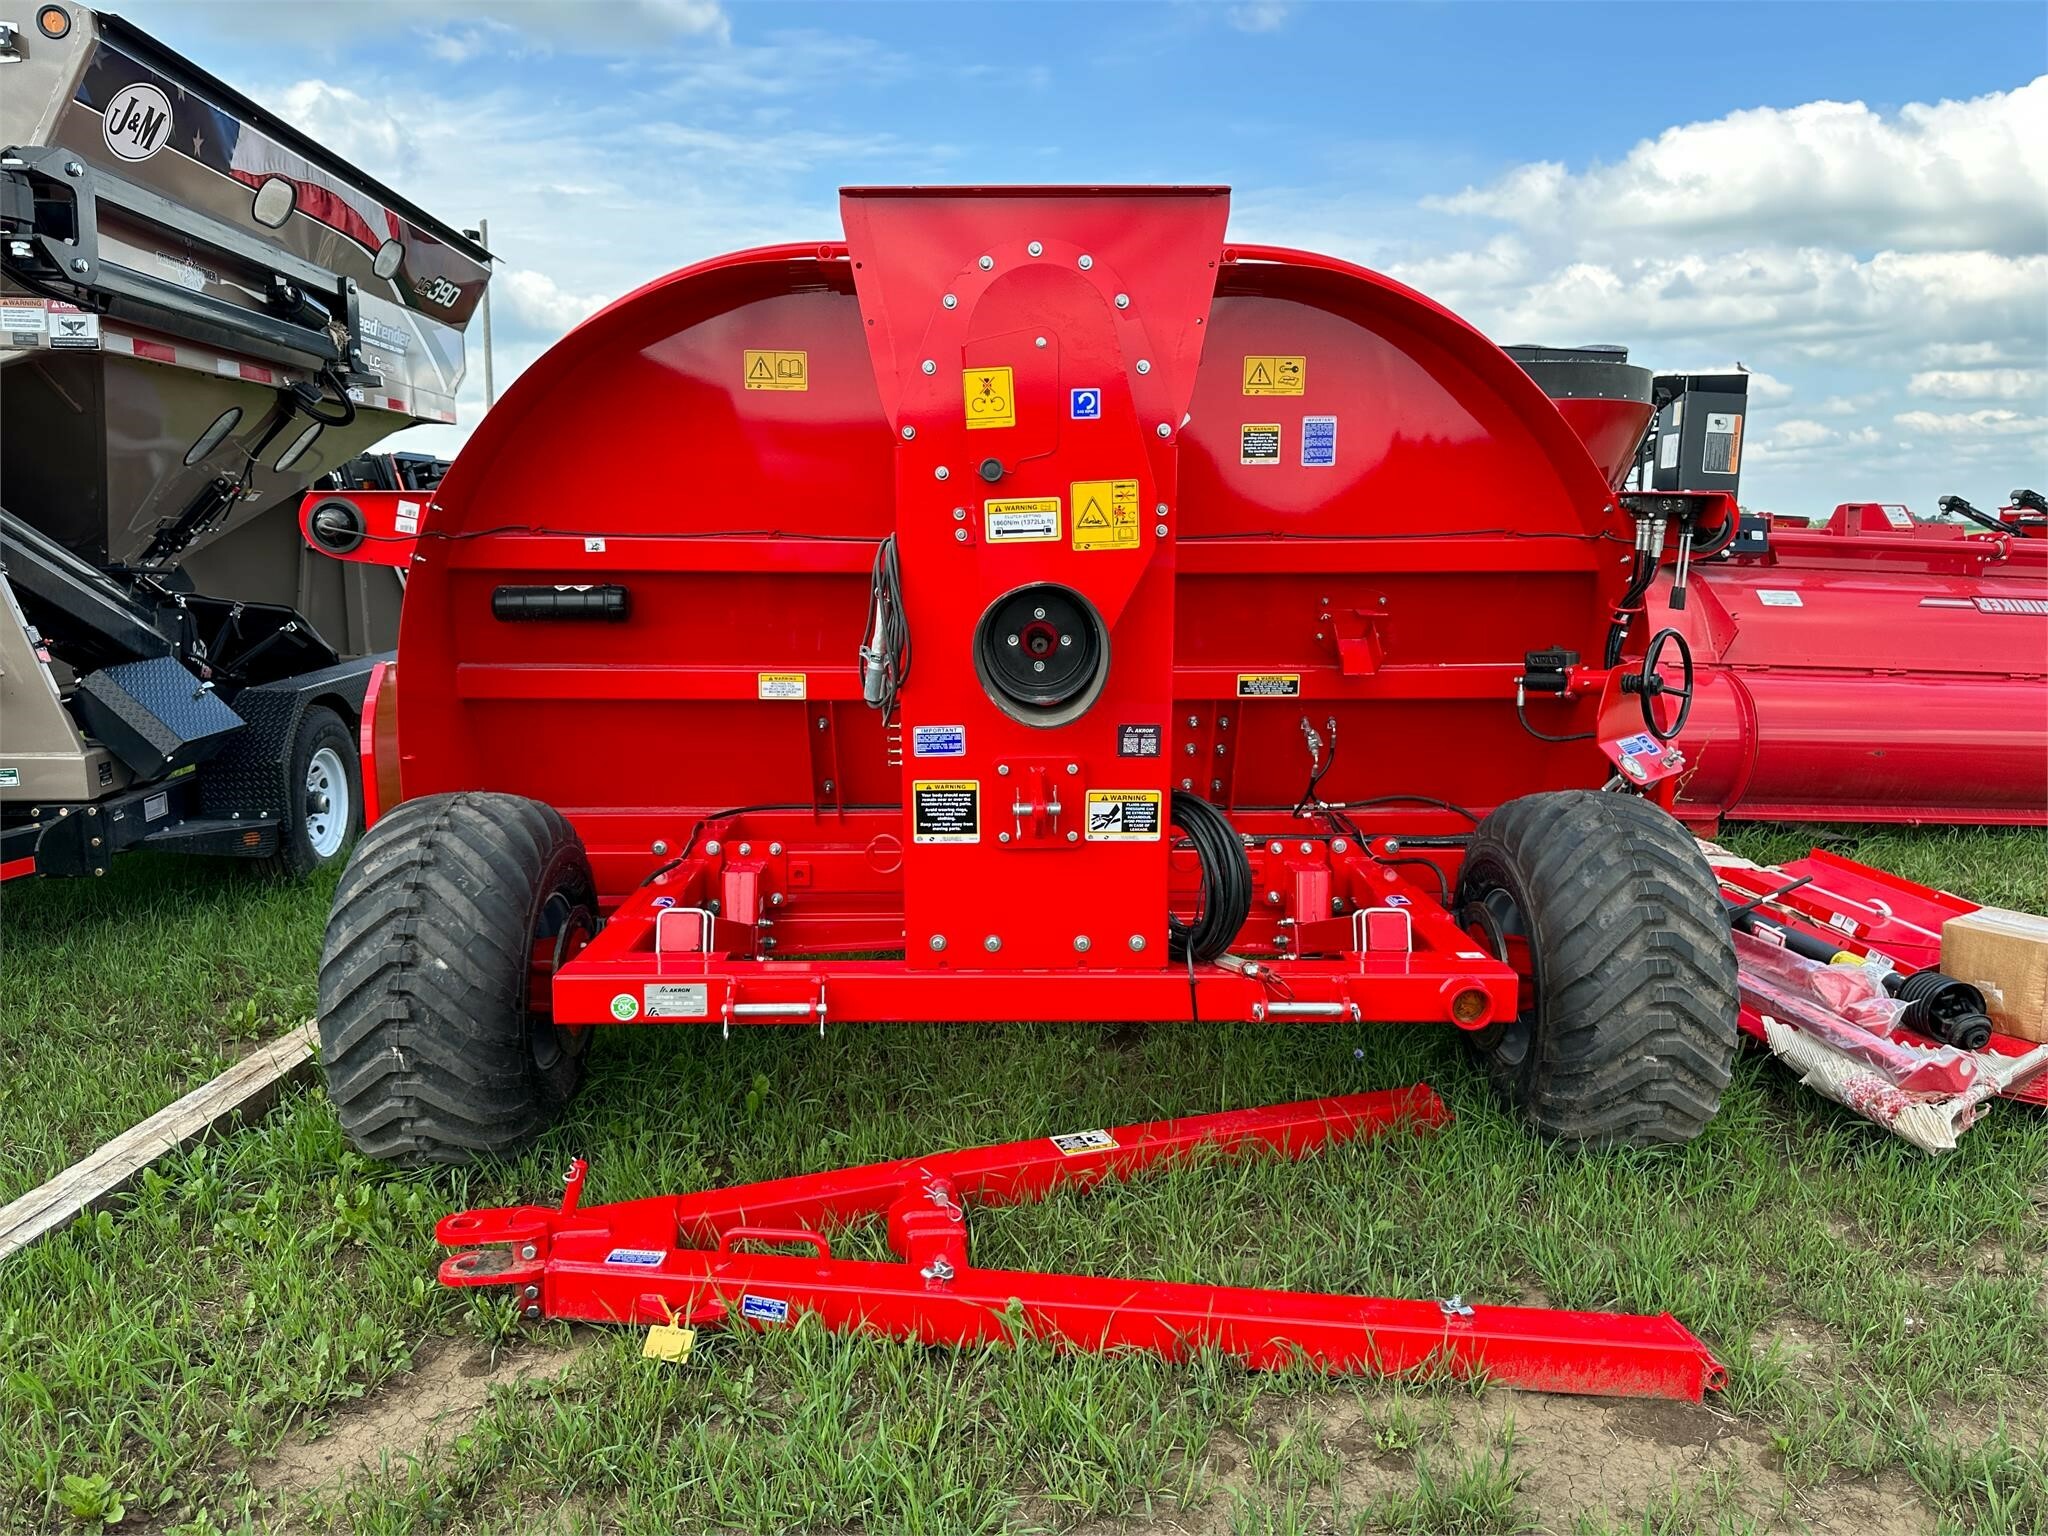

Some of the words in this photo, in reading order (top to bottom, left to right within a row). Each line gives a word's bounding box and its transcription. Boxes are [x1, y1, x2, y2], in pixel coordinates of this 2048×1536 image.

[109, 96, 167, 152] J&M
[9, 299, 42, 307] WARNING
[369, 354, 381, 368] LC
